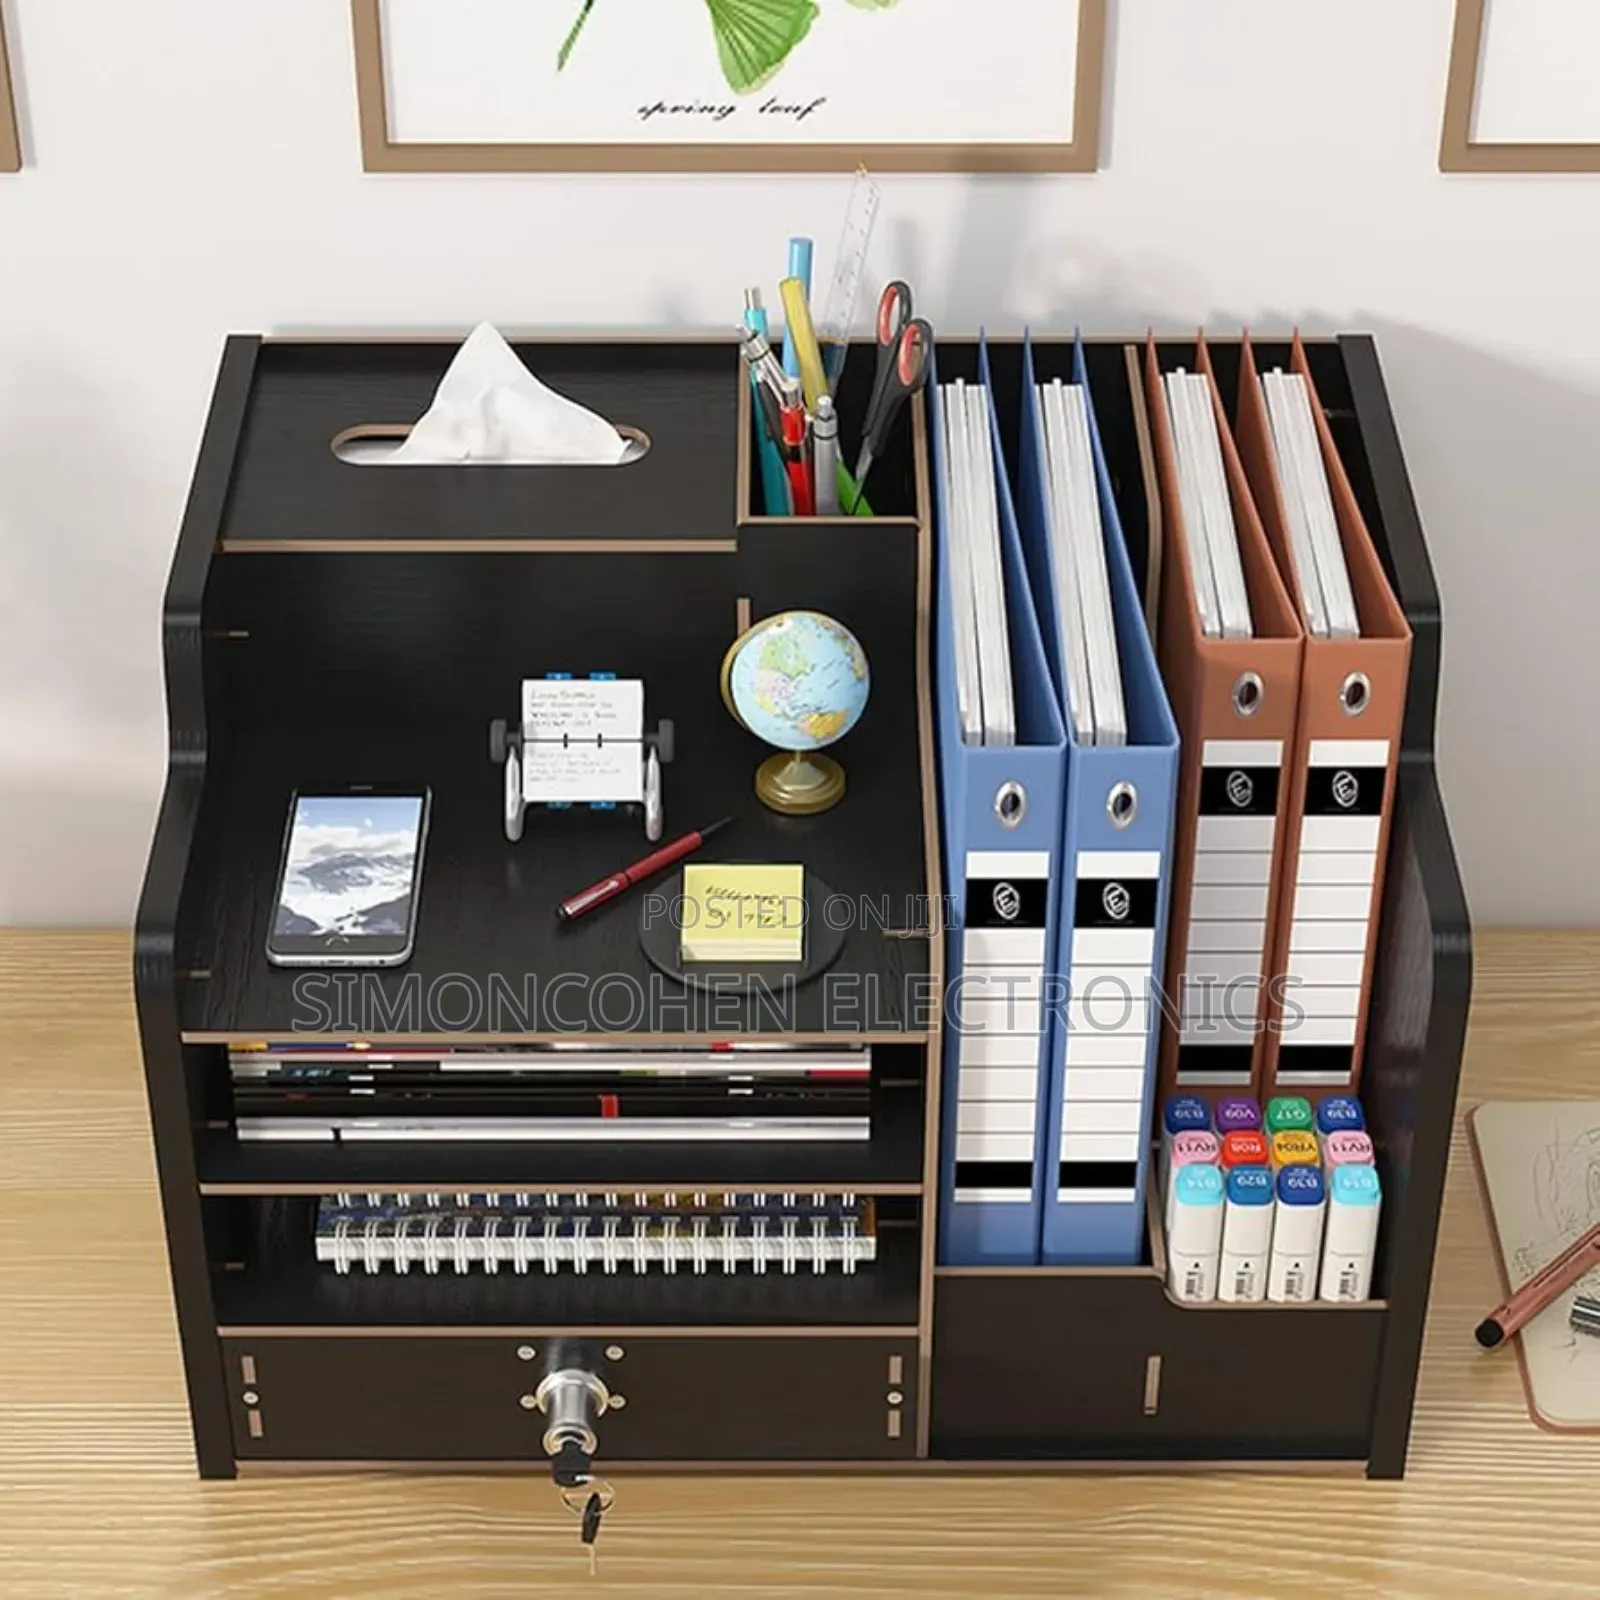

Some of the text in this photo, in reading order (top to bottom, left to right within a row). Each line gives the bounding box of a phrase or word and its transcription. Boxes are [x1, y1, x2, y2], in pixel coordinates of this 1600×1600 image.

[636, 100, 739, 121] spring
[1225, 1109, 1256, 1120] V09
[1178, 1142, 1216, 1153] RV11
[1332, 1142, 1371, 1153] RV11
